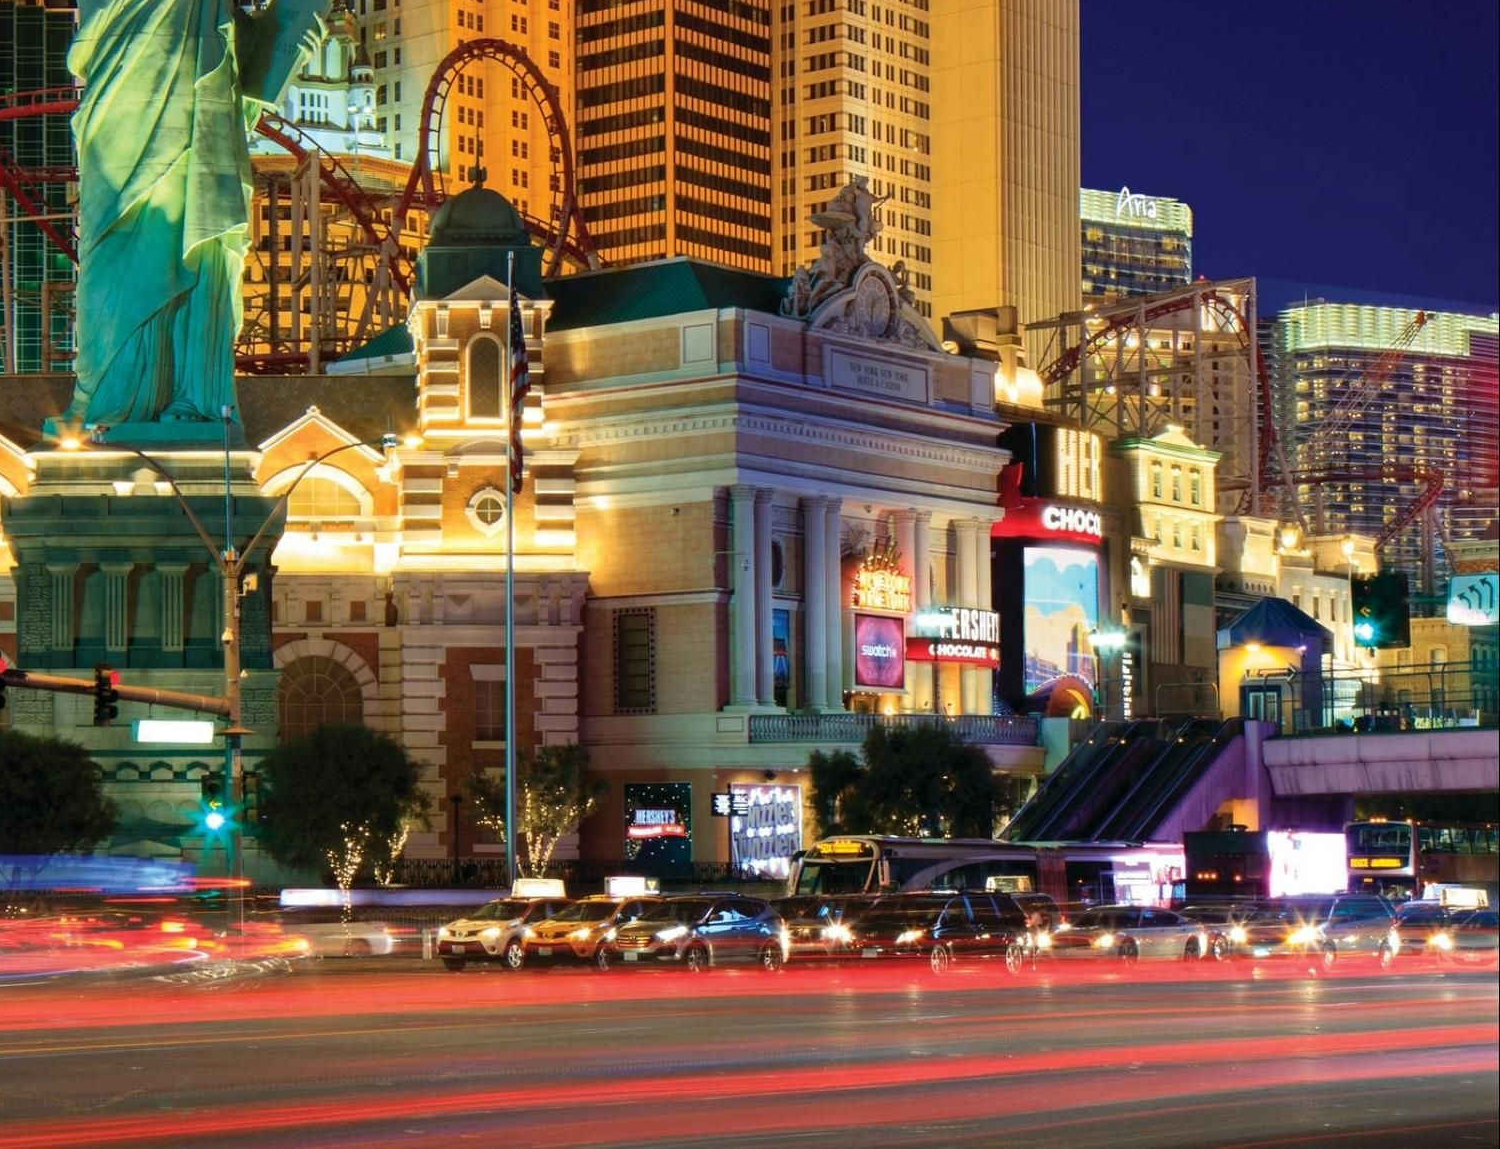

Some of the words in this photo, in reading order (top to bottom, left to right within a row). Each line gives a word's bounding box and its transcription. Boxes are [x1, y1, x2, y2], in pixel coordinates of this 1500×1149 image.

[894, 371, 909, 383] YORK
[861, 644, 891, 658] swatch
[928, 644, 987, 659] CHOCOLATE
